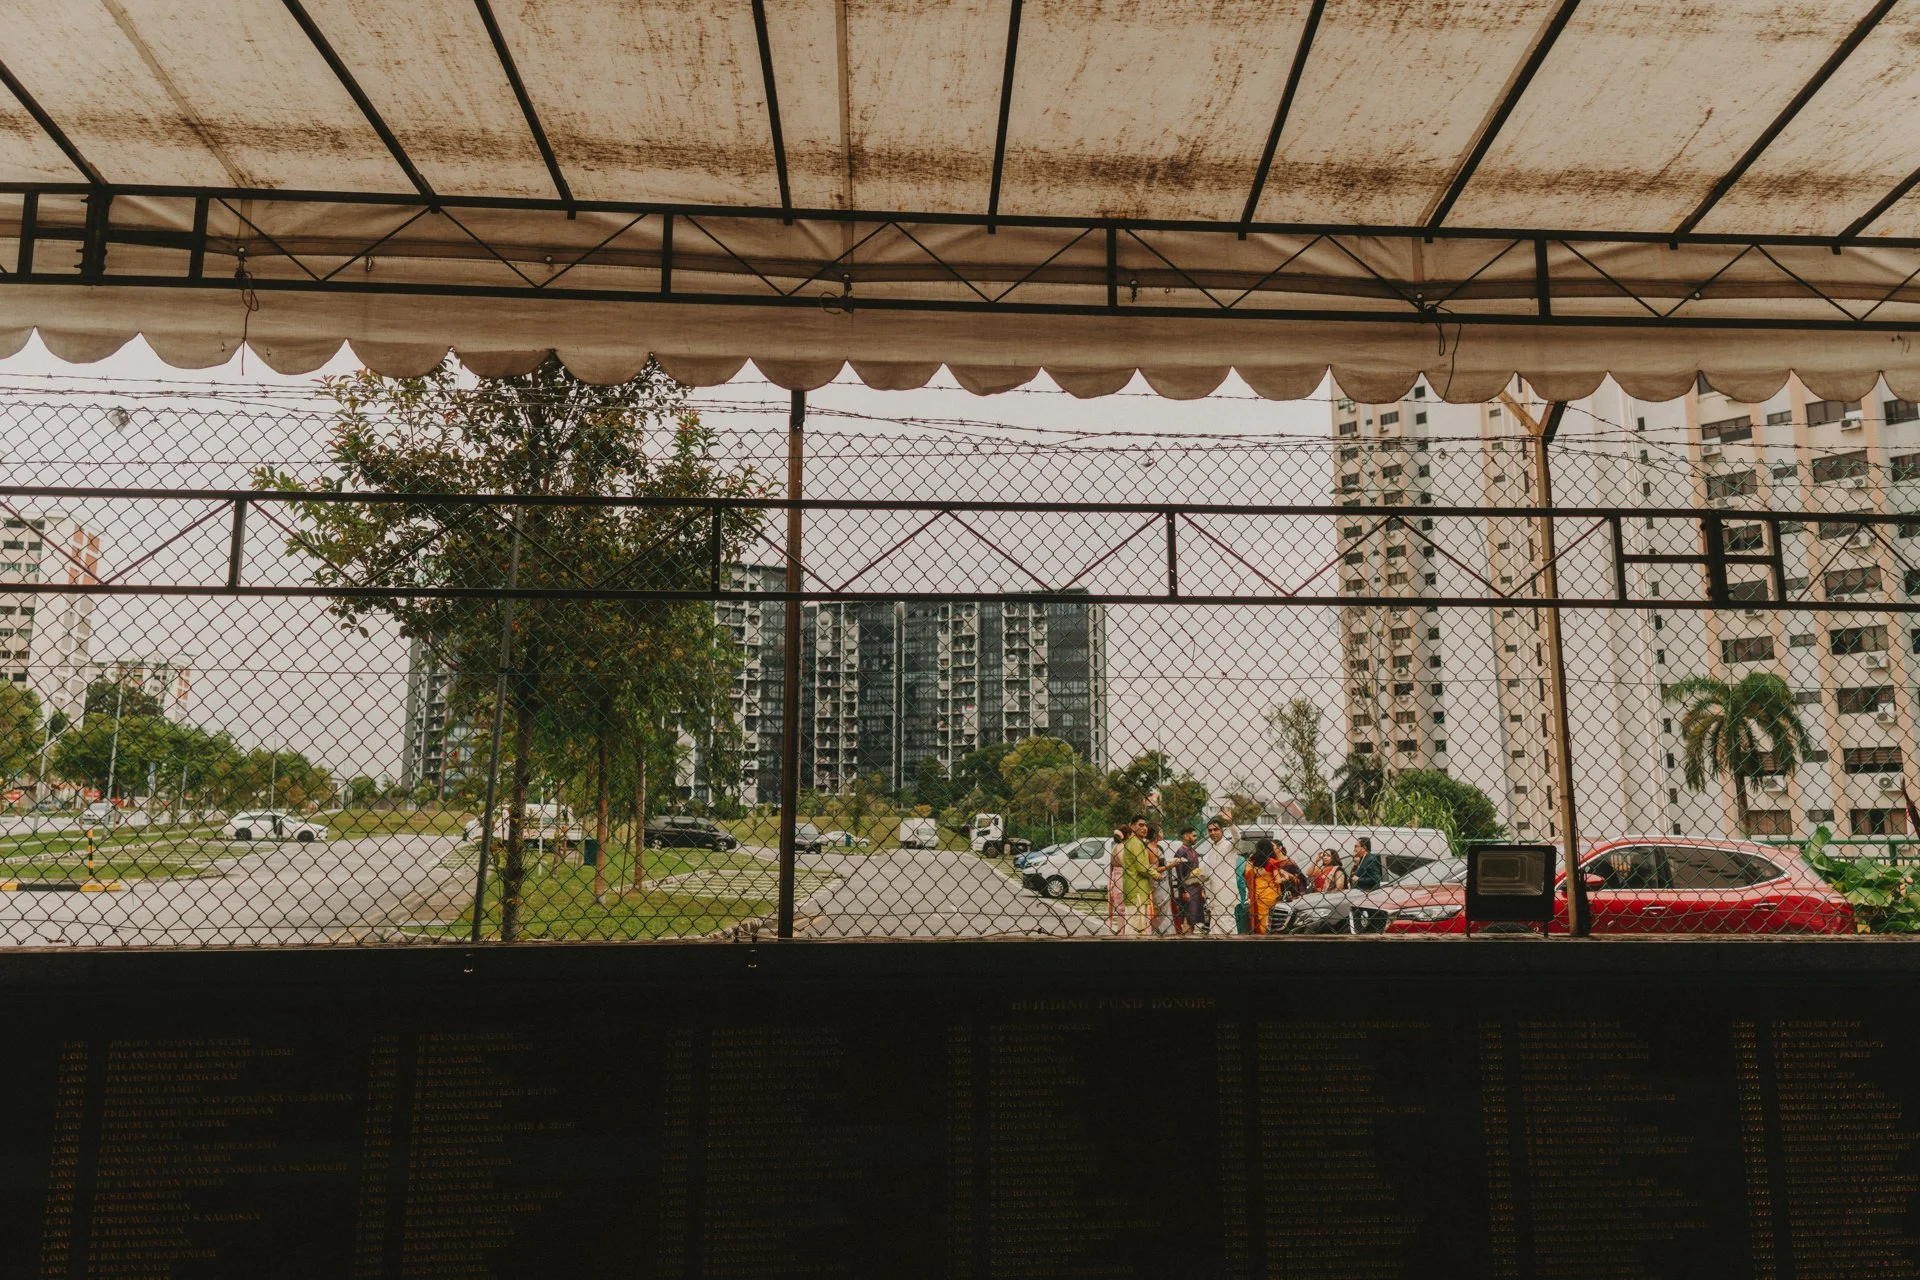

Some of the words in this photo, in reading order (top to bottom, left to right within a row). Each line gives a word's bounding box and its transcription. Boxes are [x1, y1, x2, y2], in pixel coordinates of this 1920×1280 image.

[1012, 1000, 1088, 1011] BUILDING
[1098, 999, 1143, 1010] FUND
[1152, 998, 1216, 1010] DONORS
